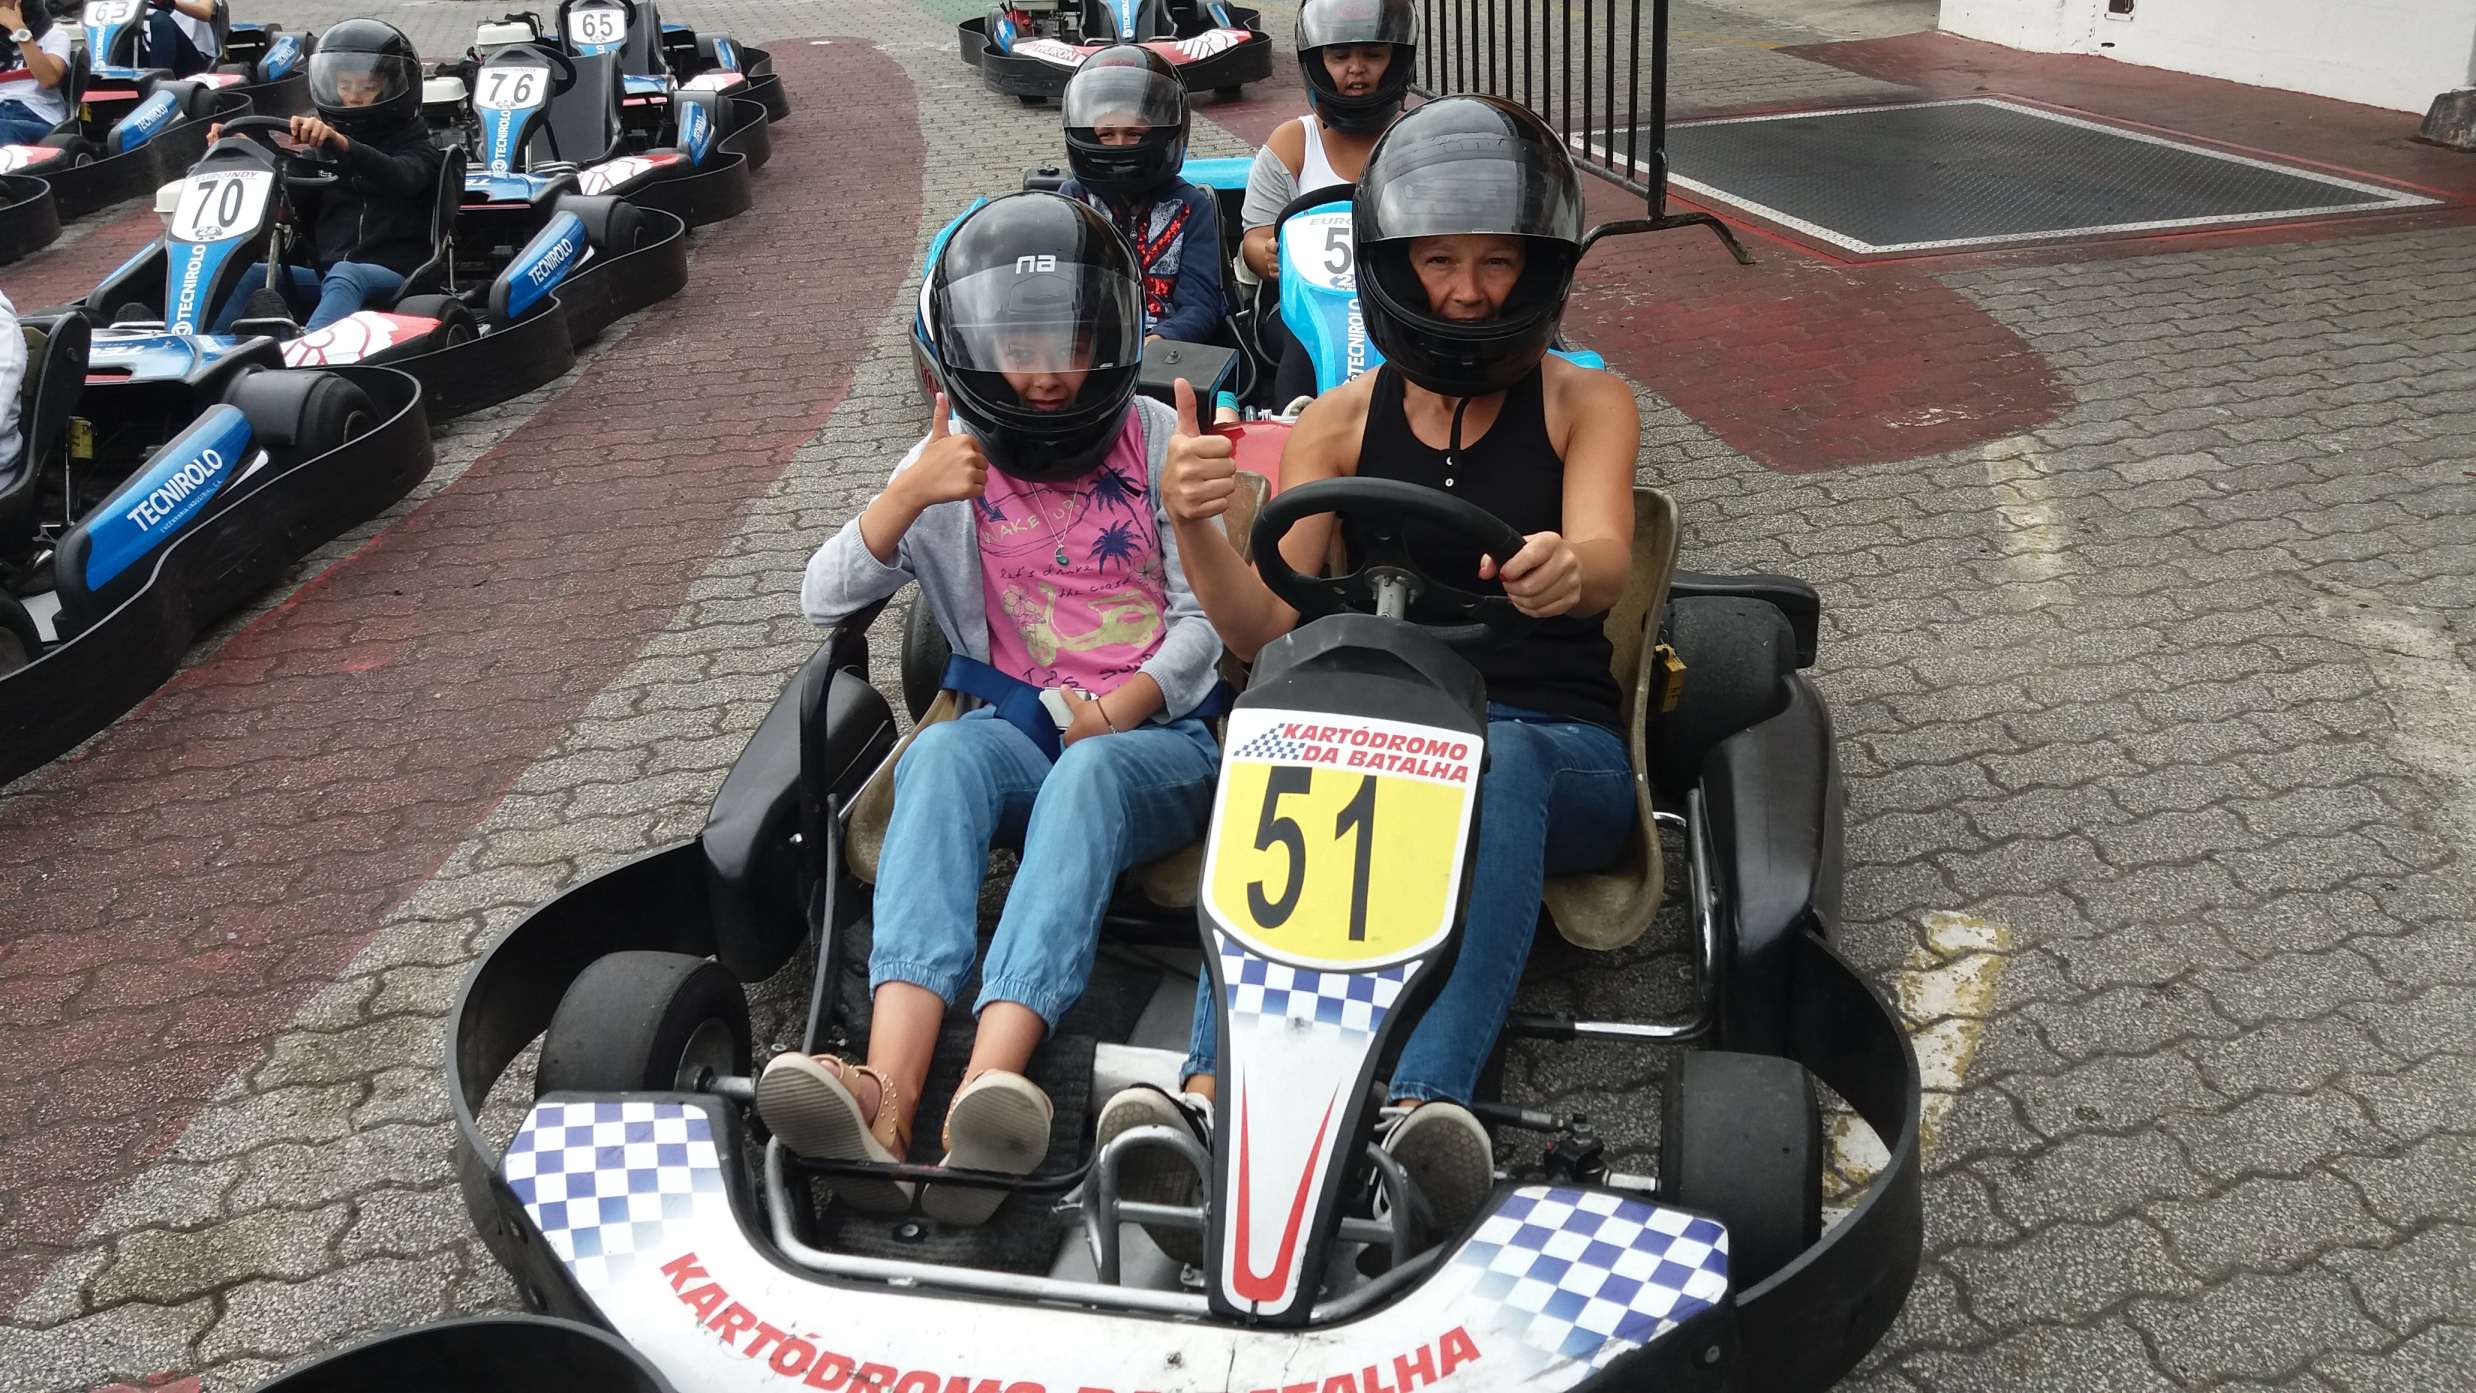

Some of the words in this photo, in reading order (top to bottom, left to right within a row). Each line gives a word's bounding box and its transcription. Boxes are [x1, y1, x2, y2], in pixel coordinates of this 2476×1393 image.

[582, 13, 613, 37] 65
[488, 73, 534, 103] 76
[495, 110, 512, 158] TECNIROLO
[192, 178, 244, 230] 70
[177, 243, 207, 321] TECNIROLO
[528, 238, 573, 287] TECNIROLO
[126, 449, 223, 532] TECNIROLO
[1282, 723, 1469, 761] KARTÓDROMO
[1301, 745, 1340, 764] DA
[1347, 750, 1470, 783] BATALHA
[1246, 765, 1378, 942] 51
[1207, 1326, 1482, 1393] ALHA
